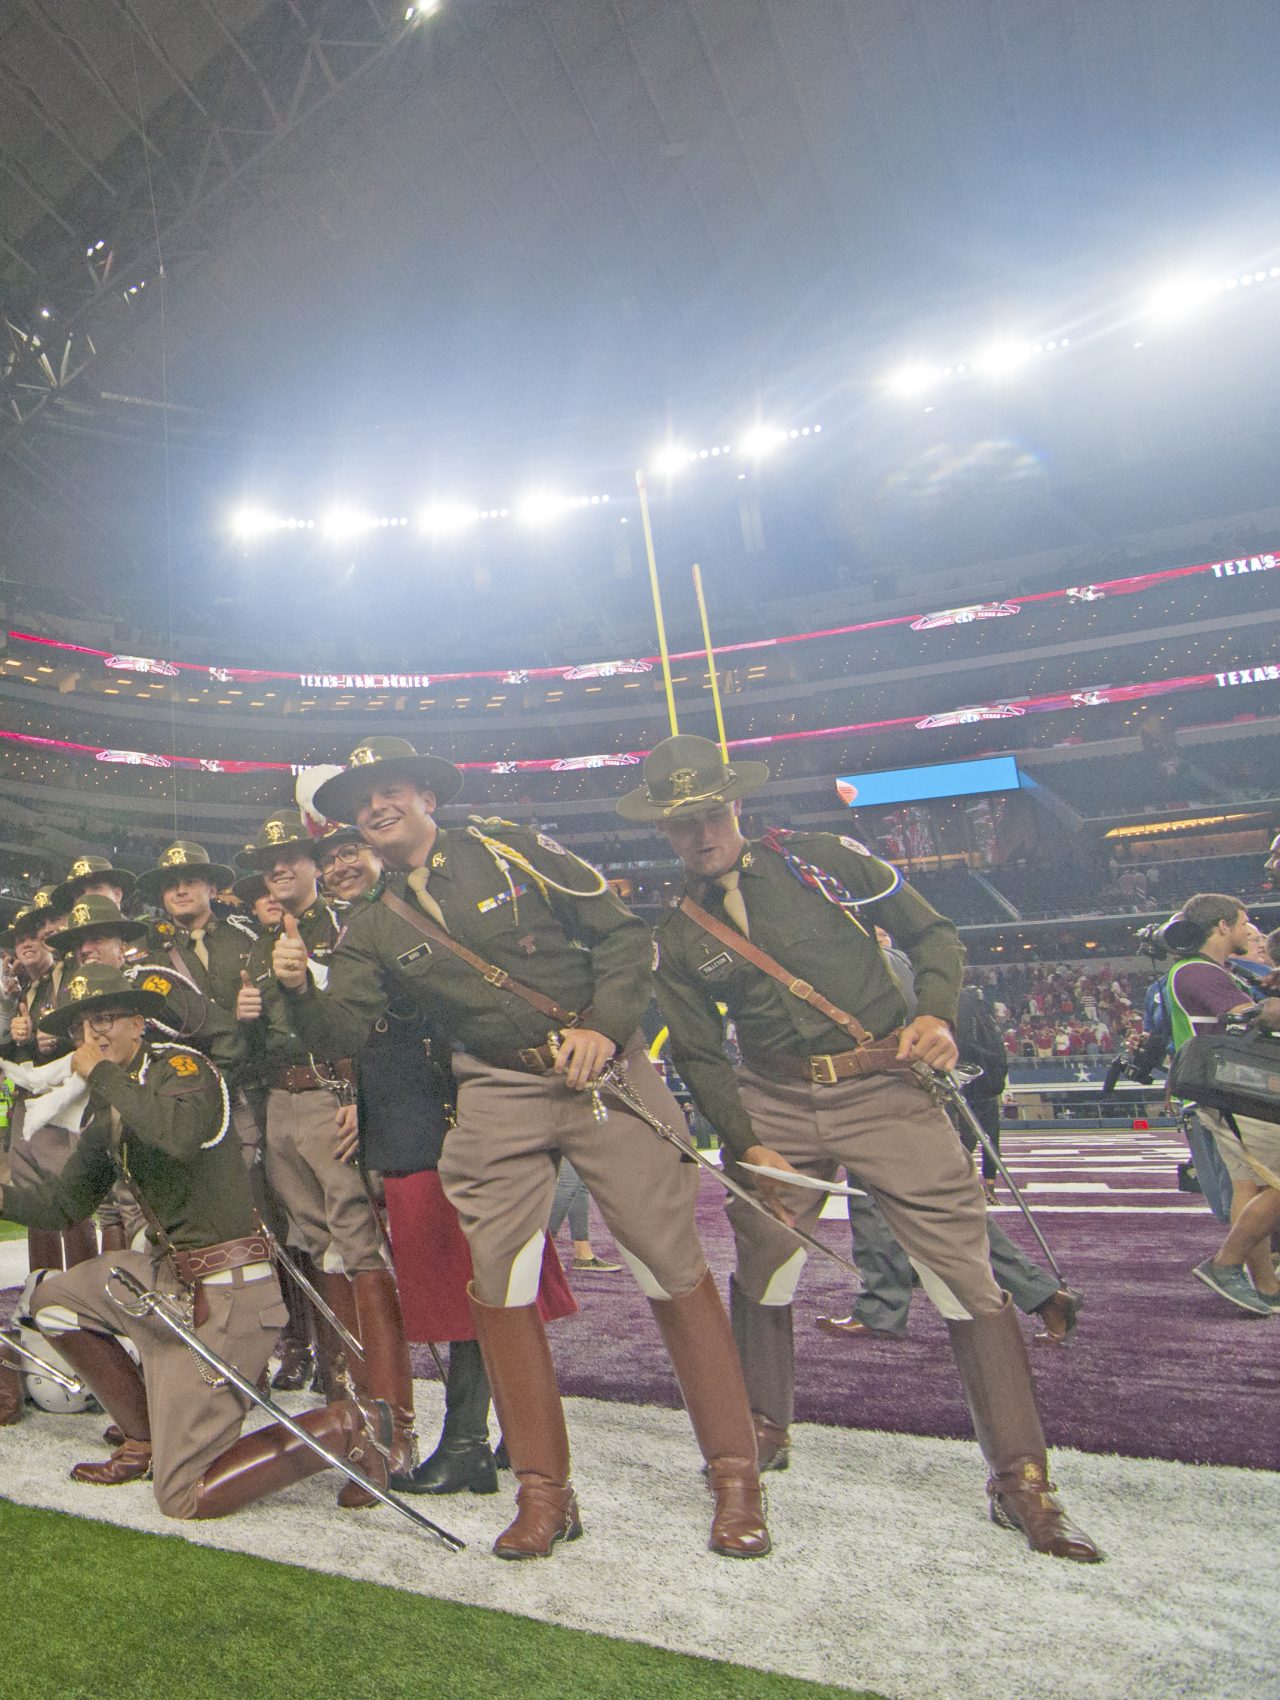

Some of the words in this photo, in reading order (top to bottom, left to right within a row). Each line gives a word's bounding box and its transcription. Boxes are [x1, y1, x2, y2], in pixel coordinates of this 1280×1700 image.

[1212, 554, 1276, 578] TEXAS
[300, 675, 338, 688] TEXAS
[1215, 665, 1280, 687] TEXAS
